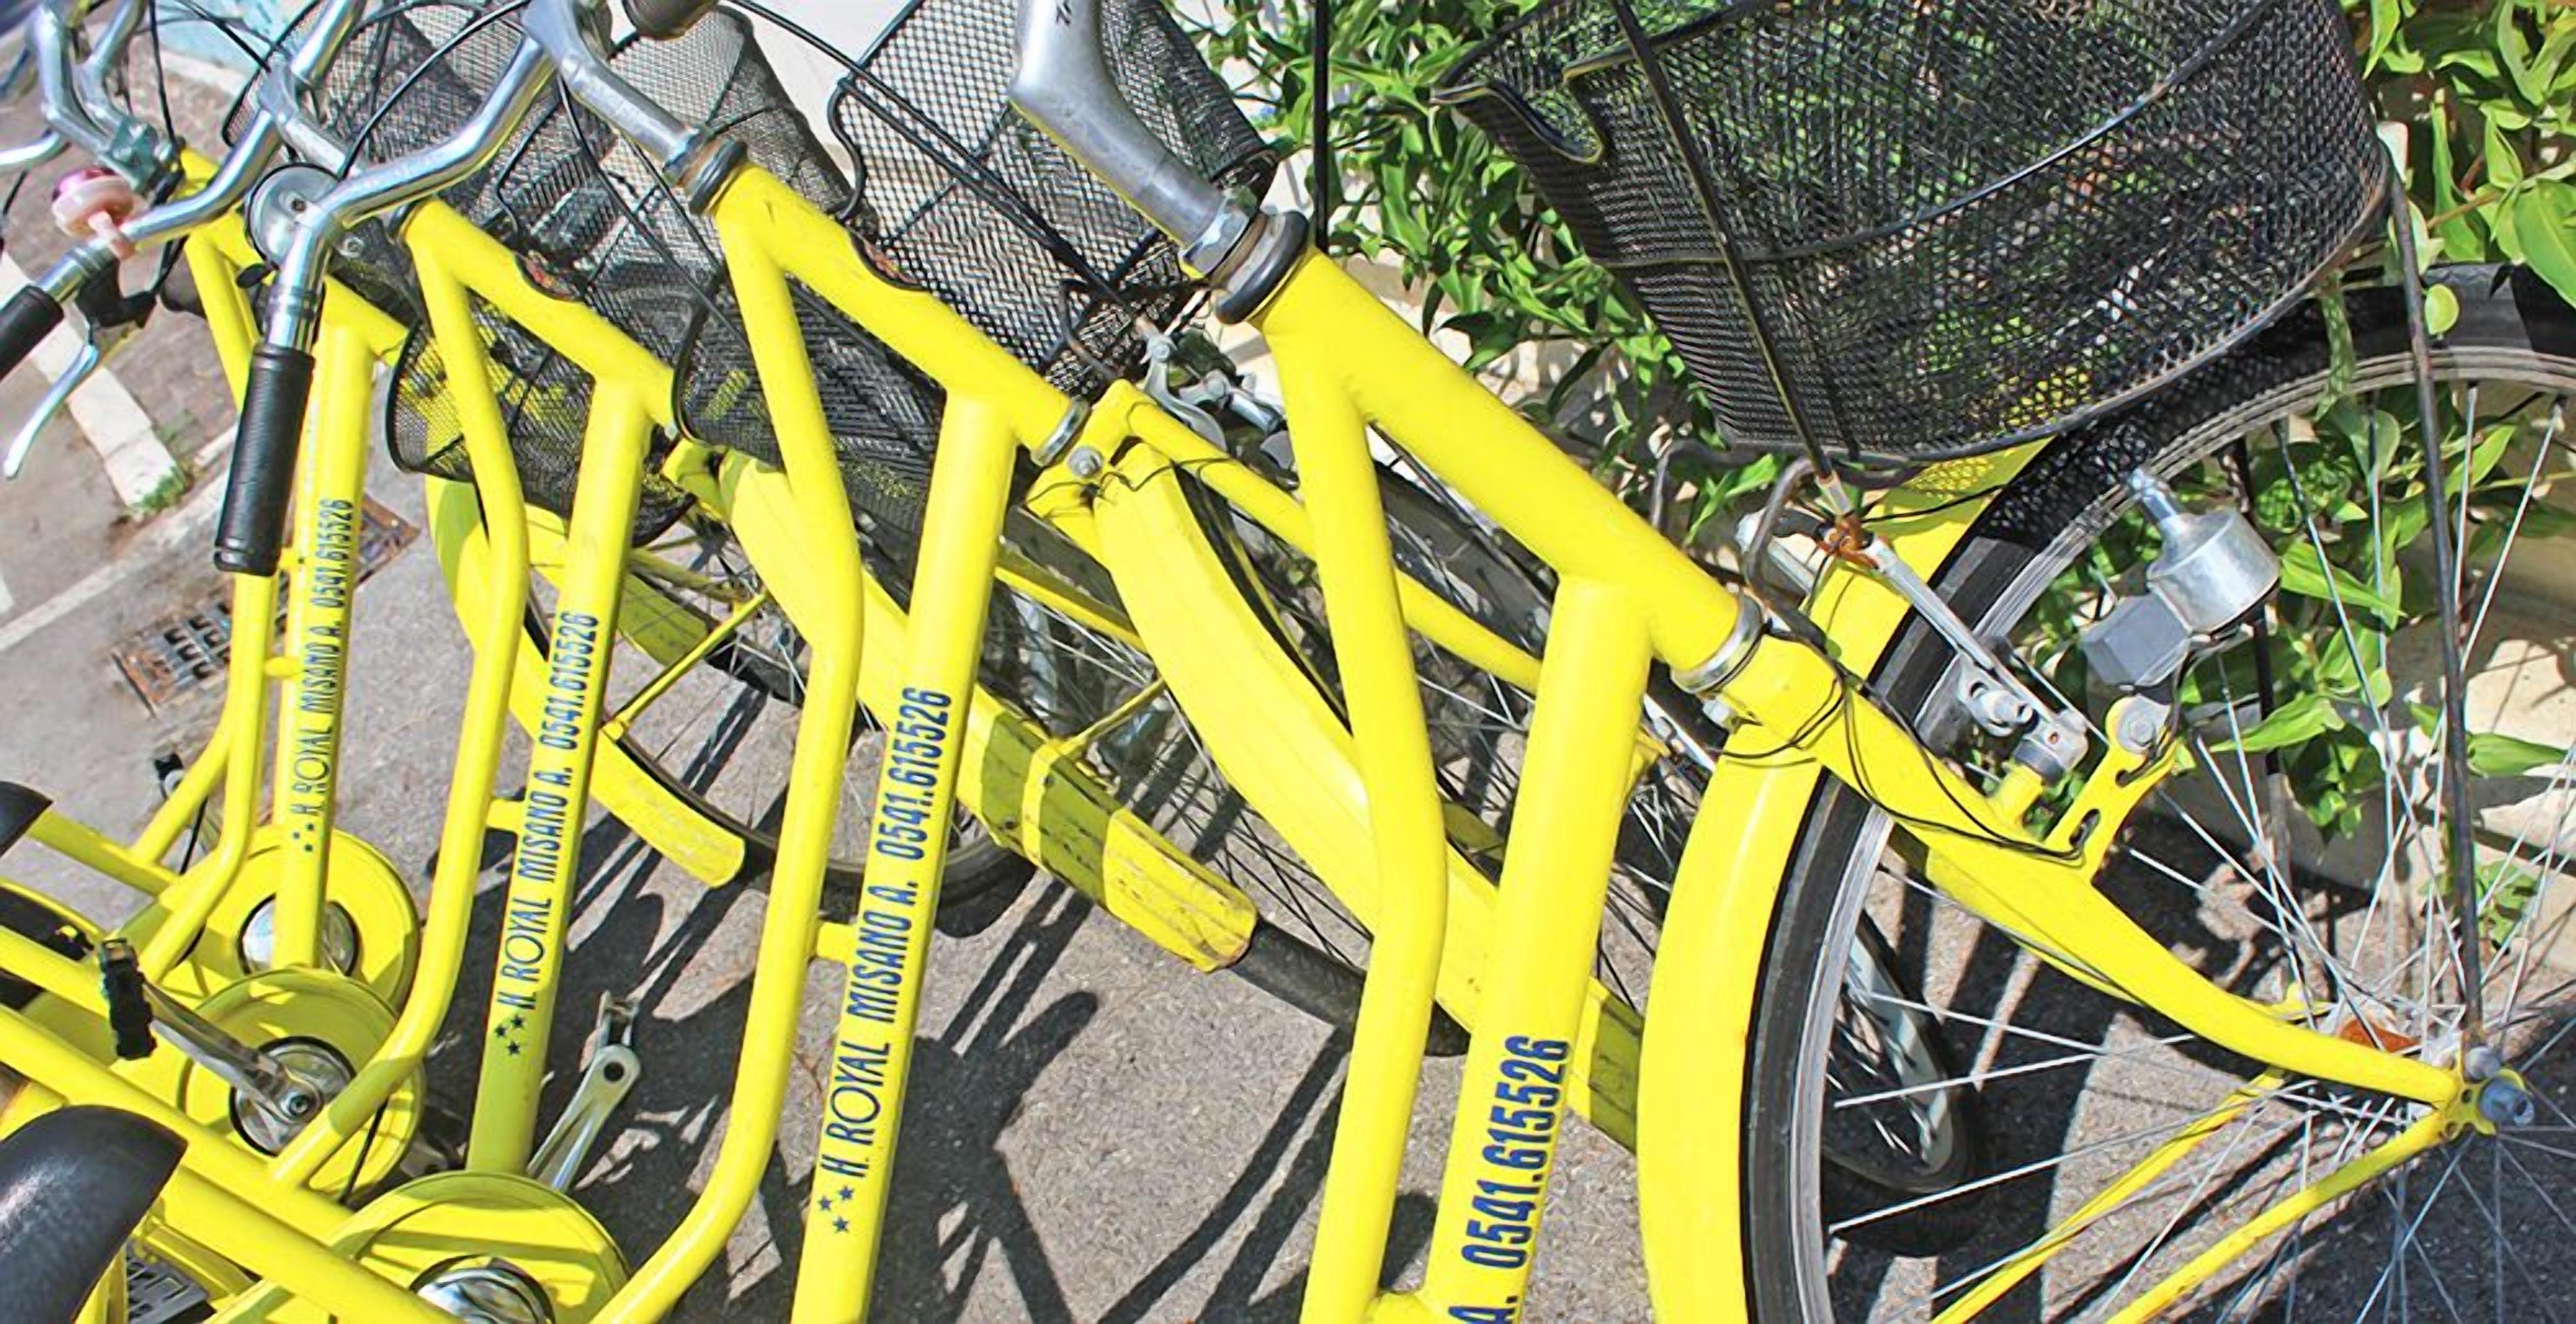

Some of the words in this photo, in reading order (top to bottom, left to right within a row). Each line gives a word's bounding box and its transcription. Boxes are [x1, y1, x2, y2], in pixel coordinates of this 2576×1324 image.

[299, 642, 340, 714] MISANO
[539, 612, 598, 750] 0541.615526
[292, 726, 334, 793] ROYAL
[533, 767, 573, 788] A.
[876, 687, 952, 860] 0541.615526
[517, 791, 567, 883] MISANO
[867, 881, 918, 906] A.
[500, 898, 552, 982] ROYAL
[846, 909, 912, 1023] MISANO
[825, 1040, 891, 1146] ROYAL
[820, 1153, 869, 1178] H.
[1461, 1035, 1570, 1269] 0541.615526
